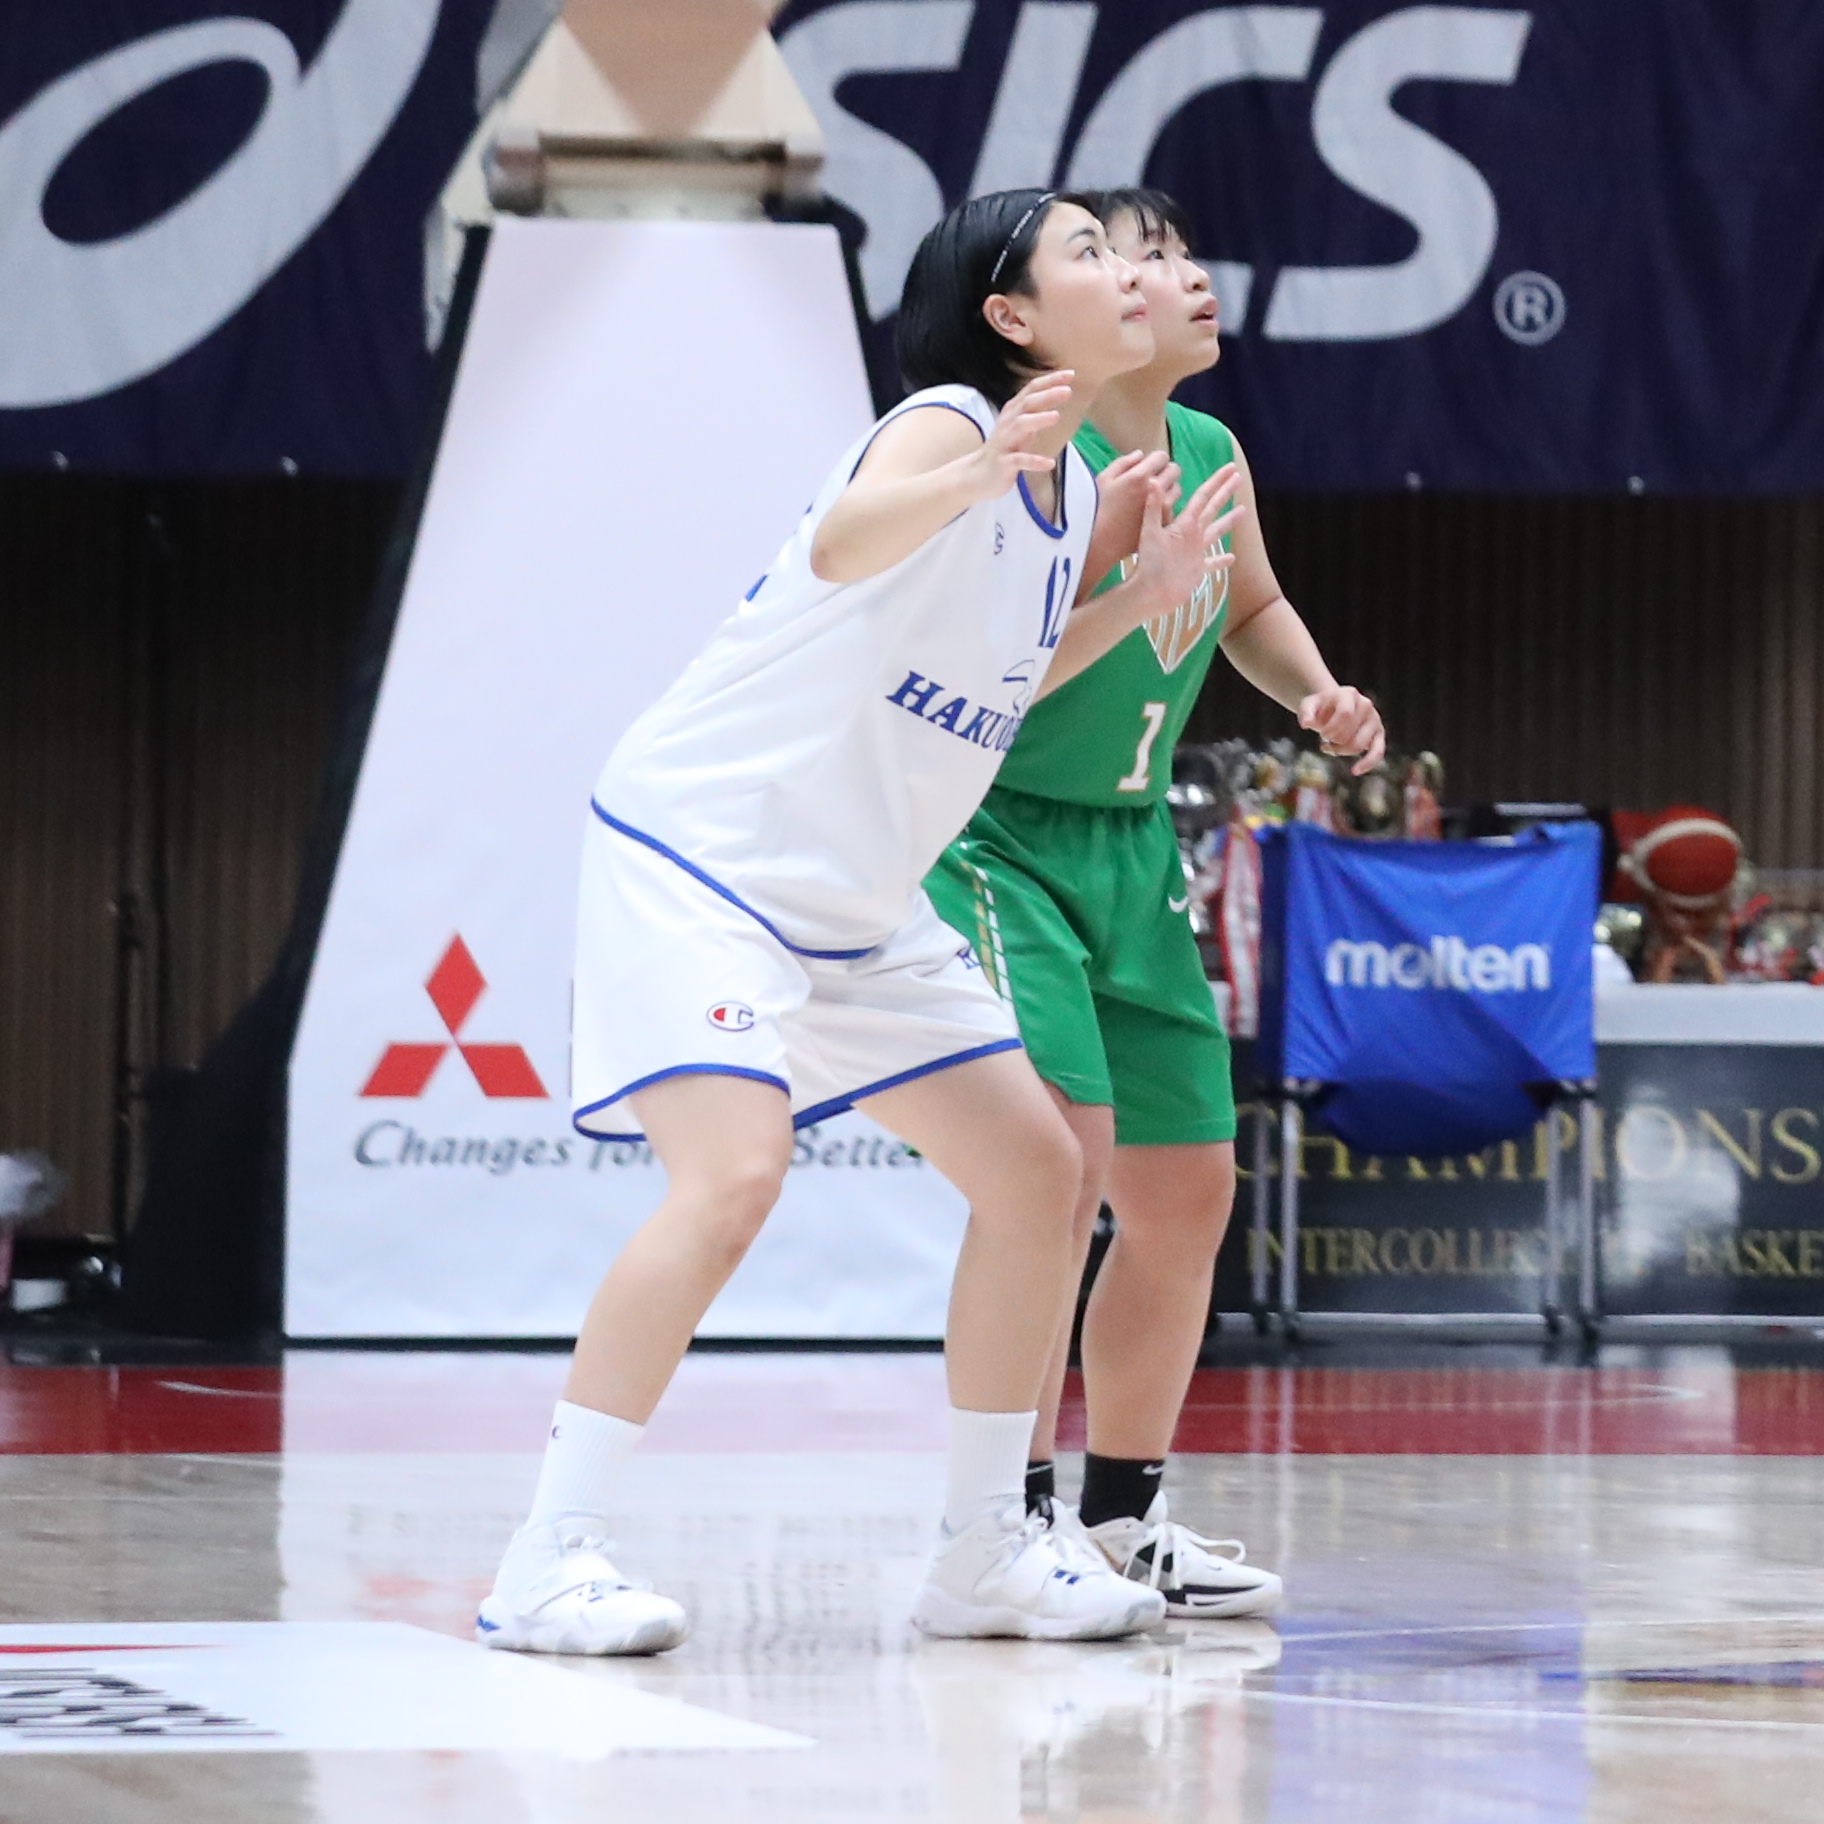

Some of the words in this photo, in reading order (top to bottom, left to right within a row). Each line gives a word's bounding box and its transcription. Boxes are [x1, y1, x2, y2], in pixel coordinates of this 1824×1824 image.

[1117, 701, 1168, 792] 1
[1325, 933, 1550, 994] molten
[353, 1117, 572, 1175] Changes
